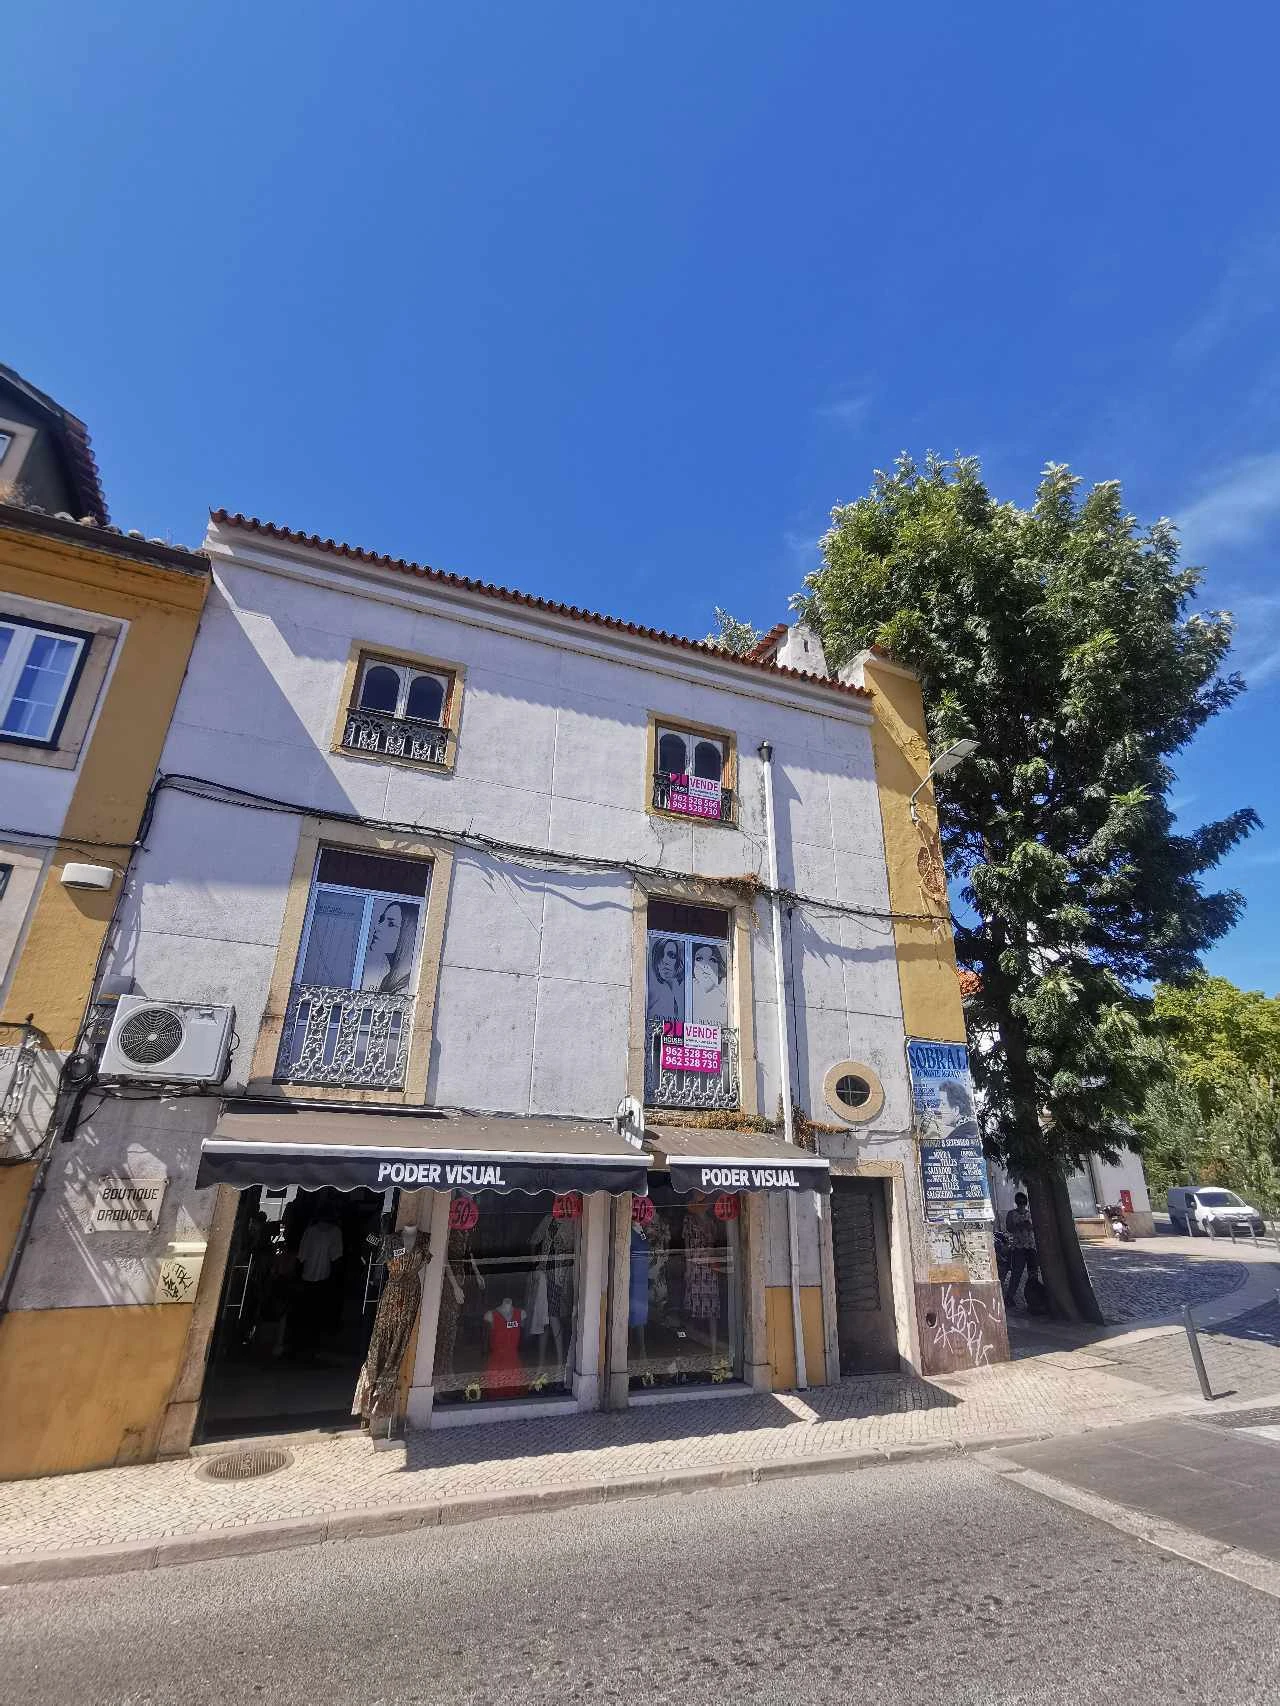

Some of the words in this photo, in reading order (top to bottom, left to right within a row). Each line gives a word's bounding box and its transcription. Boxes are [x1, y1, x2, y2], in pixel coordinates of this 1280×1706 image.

[690, 778, 719, 792] VENDE
[672, 794, 687, 803] 962
[689, 796, 702, 806] 528
[704, 799, 718, 809] 566
[672, 801, 687, 810] 962
[689, 804, 702, 813] 528
[703, 807, 718, 816] 730
[686, 1025, 718, 1040] VENDE
[665, 1046, 683, 1056] 962
[684, 1048, 701, 1058] 528
[702, 1051, 718, 1060] 566
[908, 1046, 968, 1069] SOBRAL
[665, 1055, 683, 1065] 962
[684, 1057, 701, 1067] 528
[702, 1060, 718, 1069] 730
[377, 1162, 442, 1183] PODER
[446, 1164, 506, 1186] VISUAL
[701, 1168, 750, 1186] PODER
[752, 1169, 800, 1187] VISUAL
[102, 1187, 160, 1200] BOUTIQUE
[96, 1209, 153, 1222] ORQUIDEA
